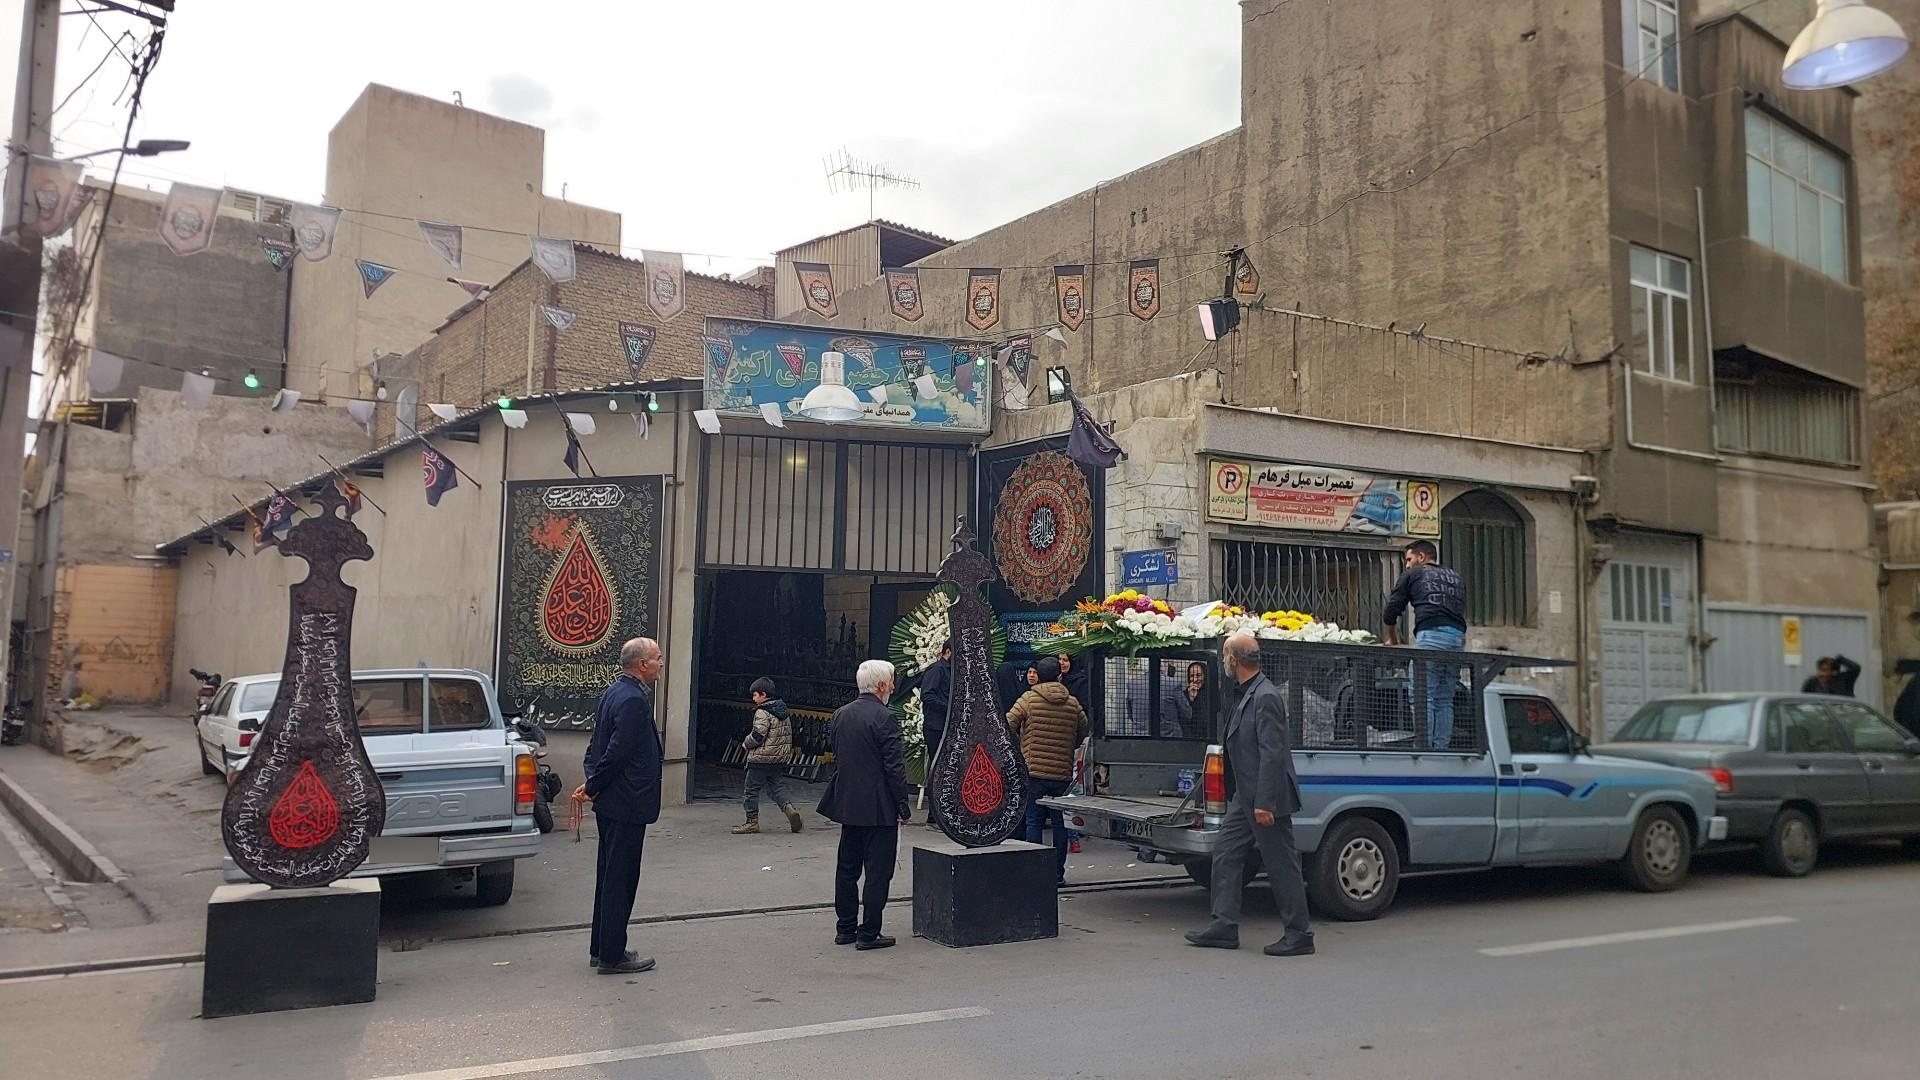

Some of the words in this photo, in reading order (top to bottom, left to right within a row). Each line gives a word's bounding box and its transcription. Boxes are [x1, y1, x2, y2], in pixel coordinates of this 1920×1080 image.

[875, 406, 911, 417] همدانیهای
[1257, 468, 1291, 487] فرهام
[1291, 471, 1312, 490] مبل
[1314, 474, 1355, 492] تعمیرات
[1165, 552, 1176, 563] ۳۸
[543, 706, 576, 728] حضرت
